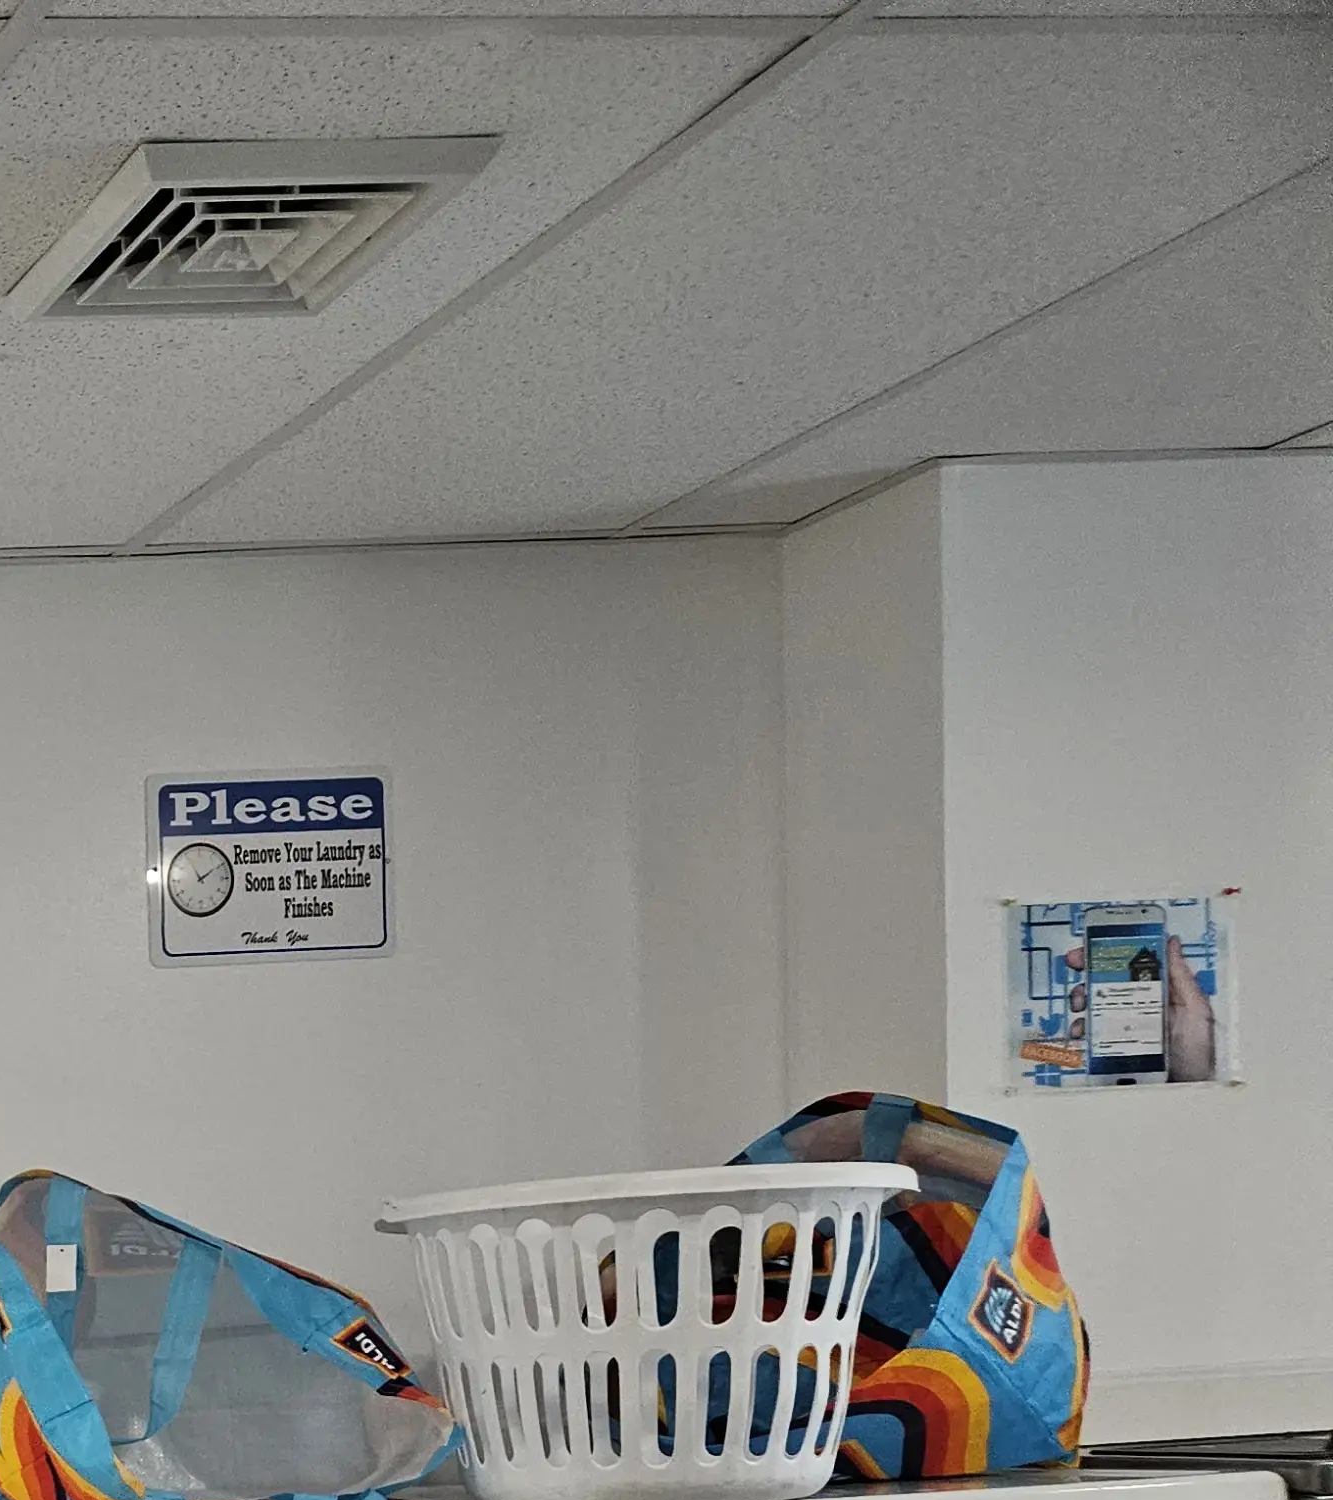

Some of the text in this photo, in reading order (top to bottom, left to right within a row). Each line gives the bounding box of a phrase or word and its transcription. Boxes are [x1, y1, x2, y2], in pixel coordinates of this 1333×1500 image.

[169, 789, 373, 826] Please
[234, 840, 381, 866] Remove Your Laundry as
[245, 868, 371, 892] Soon as The Machine
[284, 897, 333, 918] Finishes
[241, 930, 309, 946] Thank You
